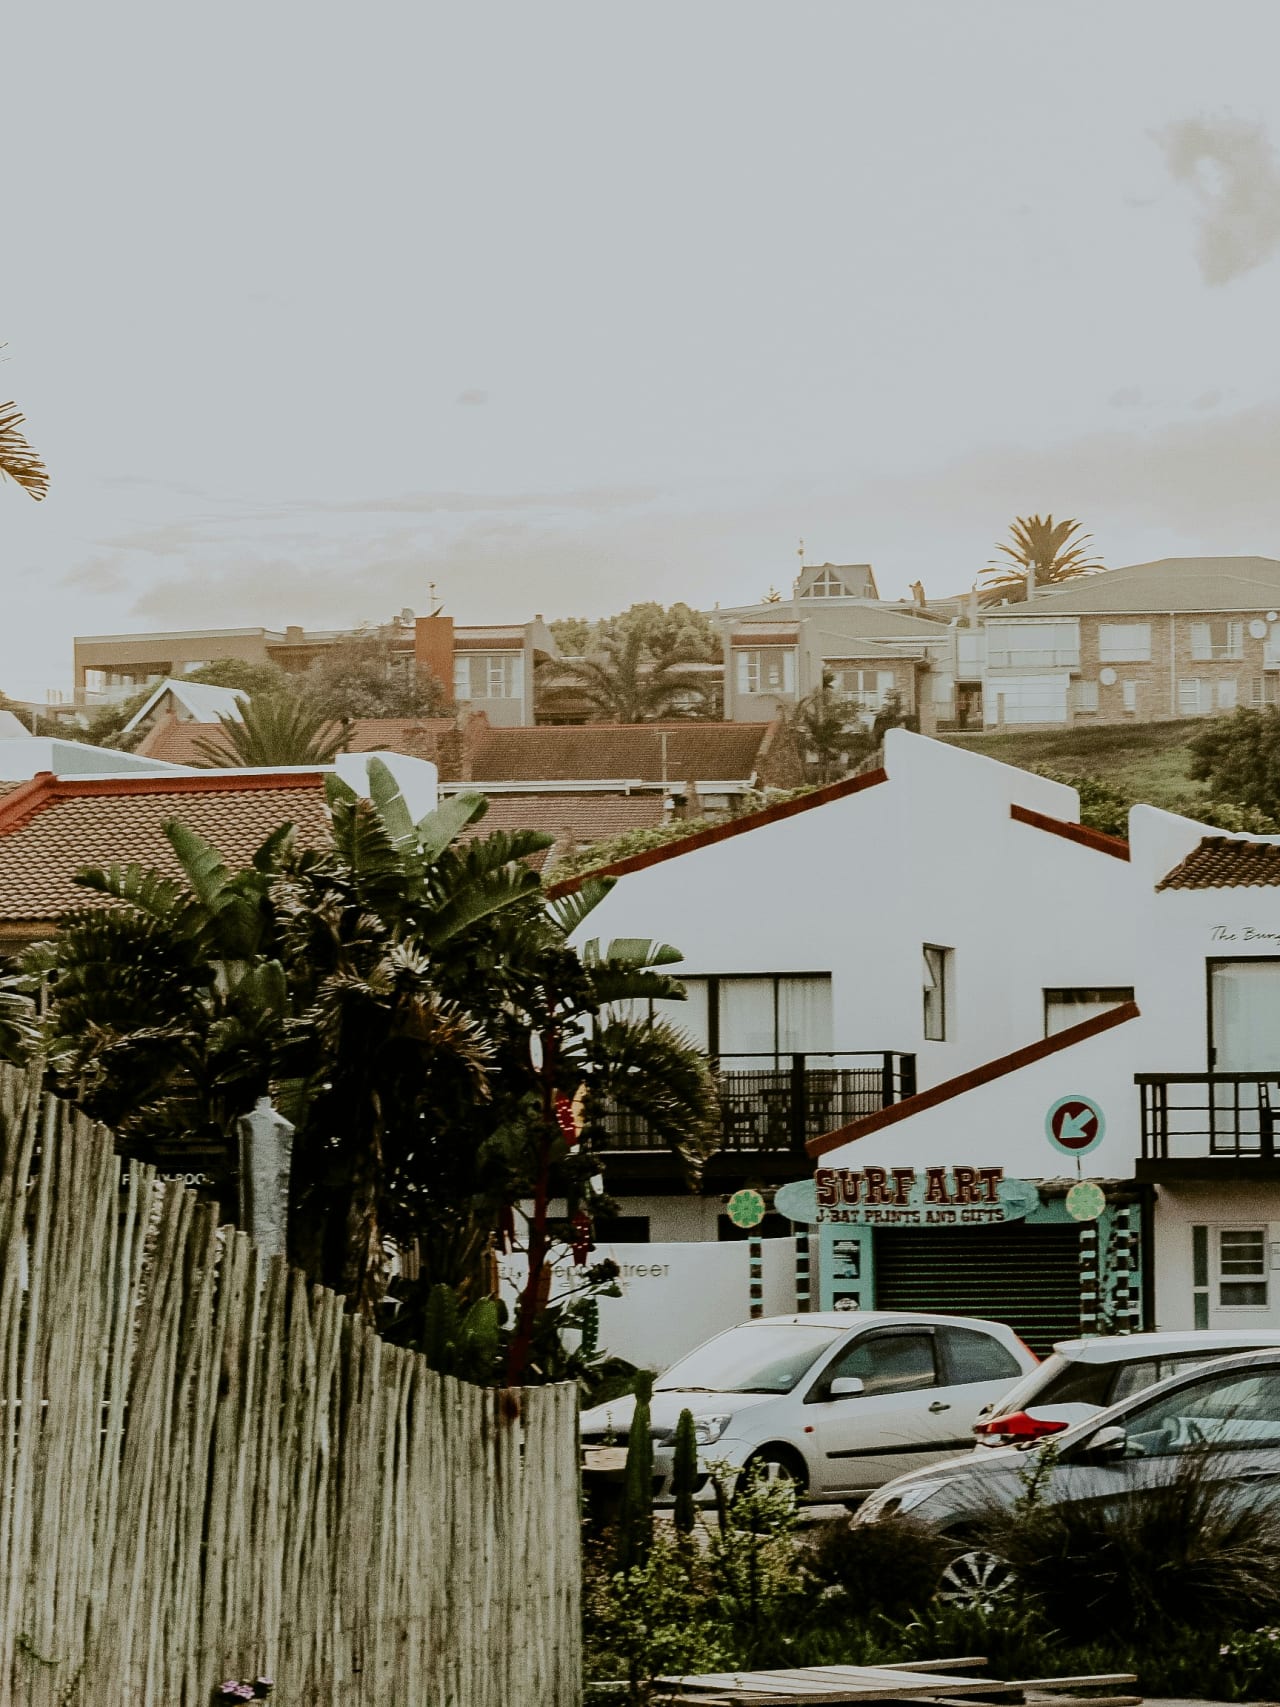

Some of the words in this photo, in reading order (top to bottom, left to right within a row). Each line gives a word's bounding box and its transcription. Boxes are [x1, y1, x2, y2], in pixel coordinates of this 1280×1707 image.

[1210, 925, 1237, 942] The
[814, 1165, 916, 1207] SURF
[925, 1165, 1005, 1206] ART
[816, 1209, 860, 1223] J-BAY
[864, 1209, 921, 1224] PRINTS
[926, 1209, 957, 1223] AND
[960, 1208, 1005, 1222] GIFTS
[616, 1262, 670, 1277] treet
